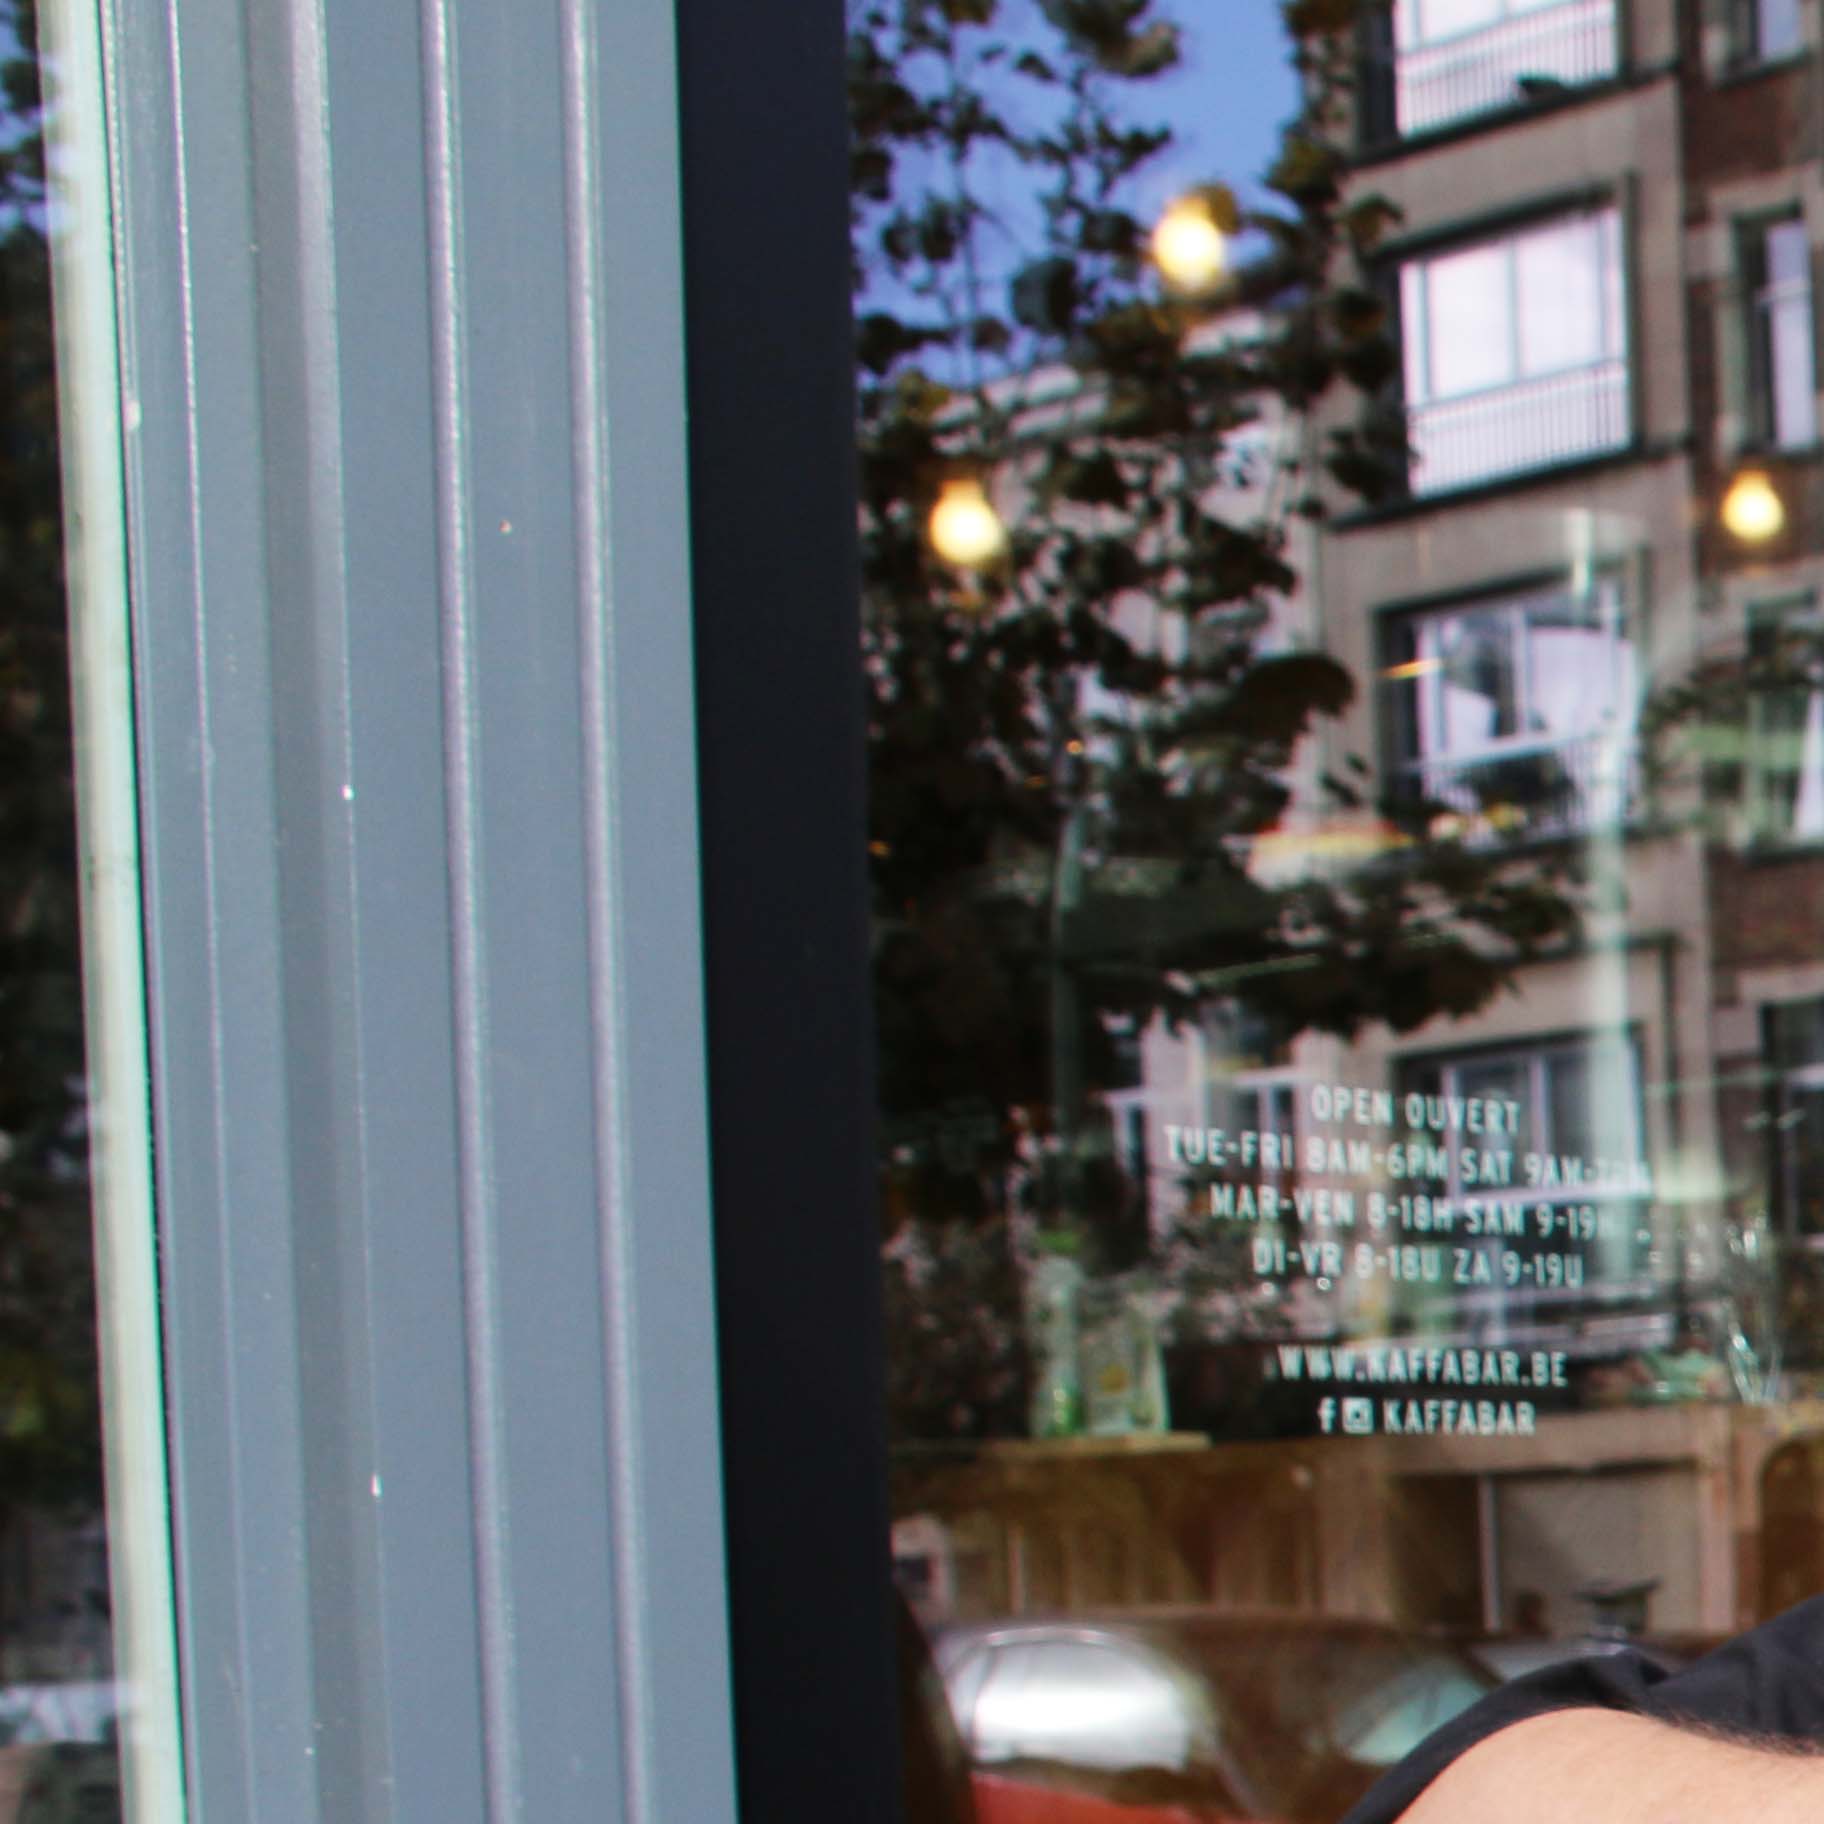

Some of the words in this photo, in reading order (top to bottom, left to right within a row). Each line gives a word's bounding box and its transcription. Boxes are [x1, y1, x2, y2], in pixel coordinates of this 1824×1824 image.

[1311, 1084, 1395, 1127] OPEN
[1405, 1092, 1521, 1136] OUVERT
[1164, 1124, 1294, 1170] TUE-FRI
[1306, 1136, 1449, 1179] 8AM-6PM
[1460, 1147, 1514, 1186] SAT
[1210, 1182, 1355, 1227] MAR-VEN
[1464, 1198, 1525, 1237] SAM
[1253, 1237, 1343, 1278] DI-VR
[1453, 1248, 1491, 1285] ZA
[1502, 1251, 1584, 1290] 9-19U
[1277, 1344, 1569, 1388] WWW.KAFFABAR.BE
[1382, 1399, 1536, 1436] KAFFABAR
